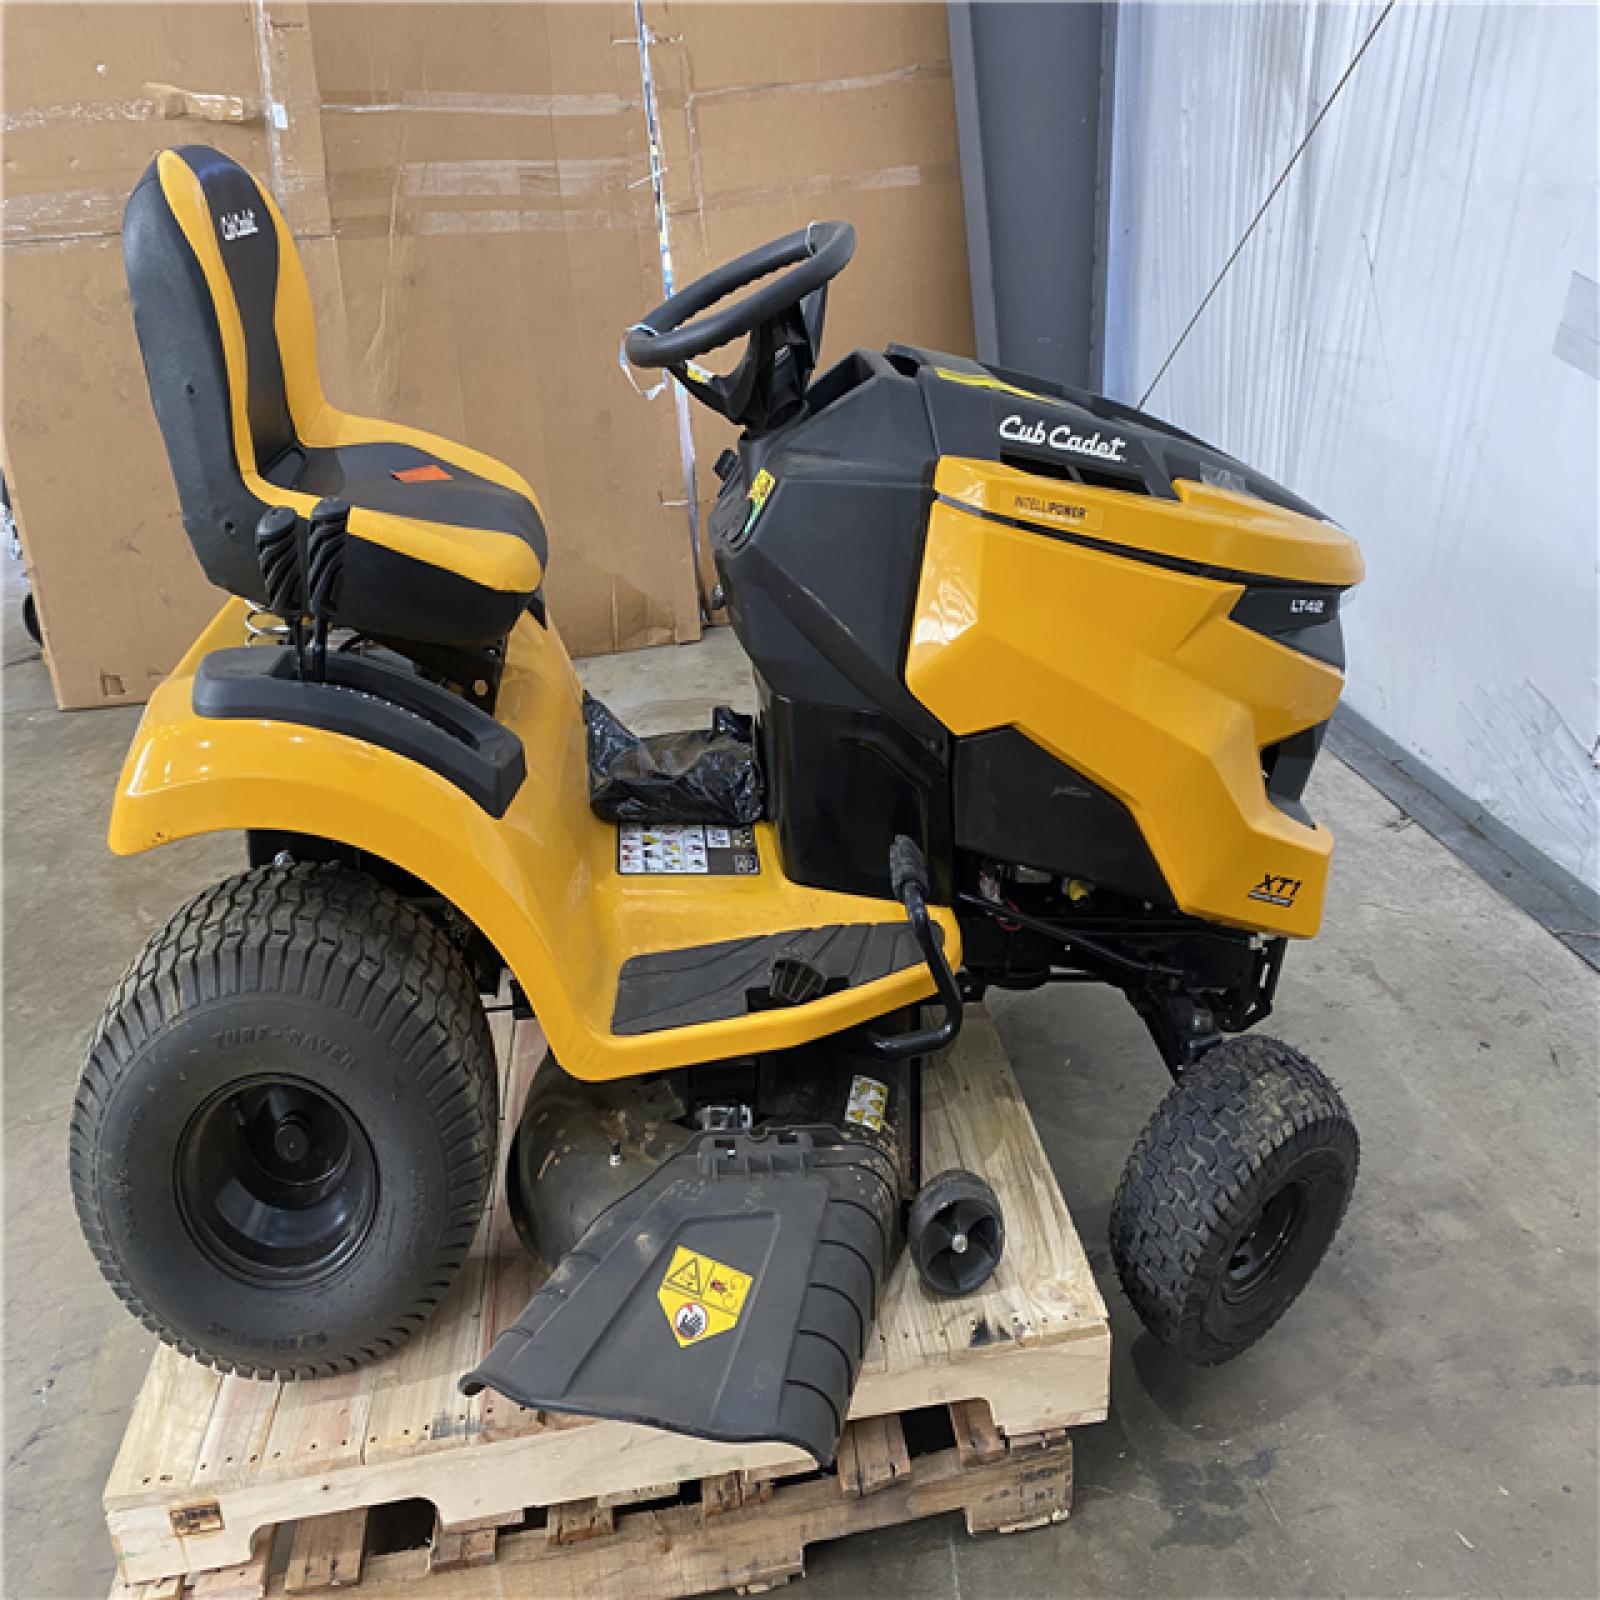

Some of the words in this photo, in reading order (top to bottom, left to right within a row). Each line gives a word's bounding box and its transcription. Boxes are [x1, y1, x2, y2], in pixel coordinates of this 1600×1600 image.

[999, 414, 1046, 445] Cub
[1049, 424, 1126, 462] Cadet
[1253, 873, 1303, 897] XT1
